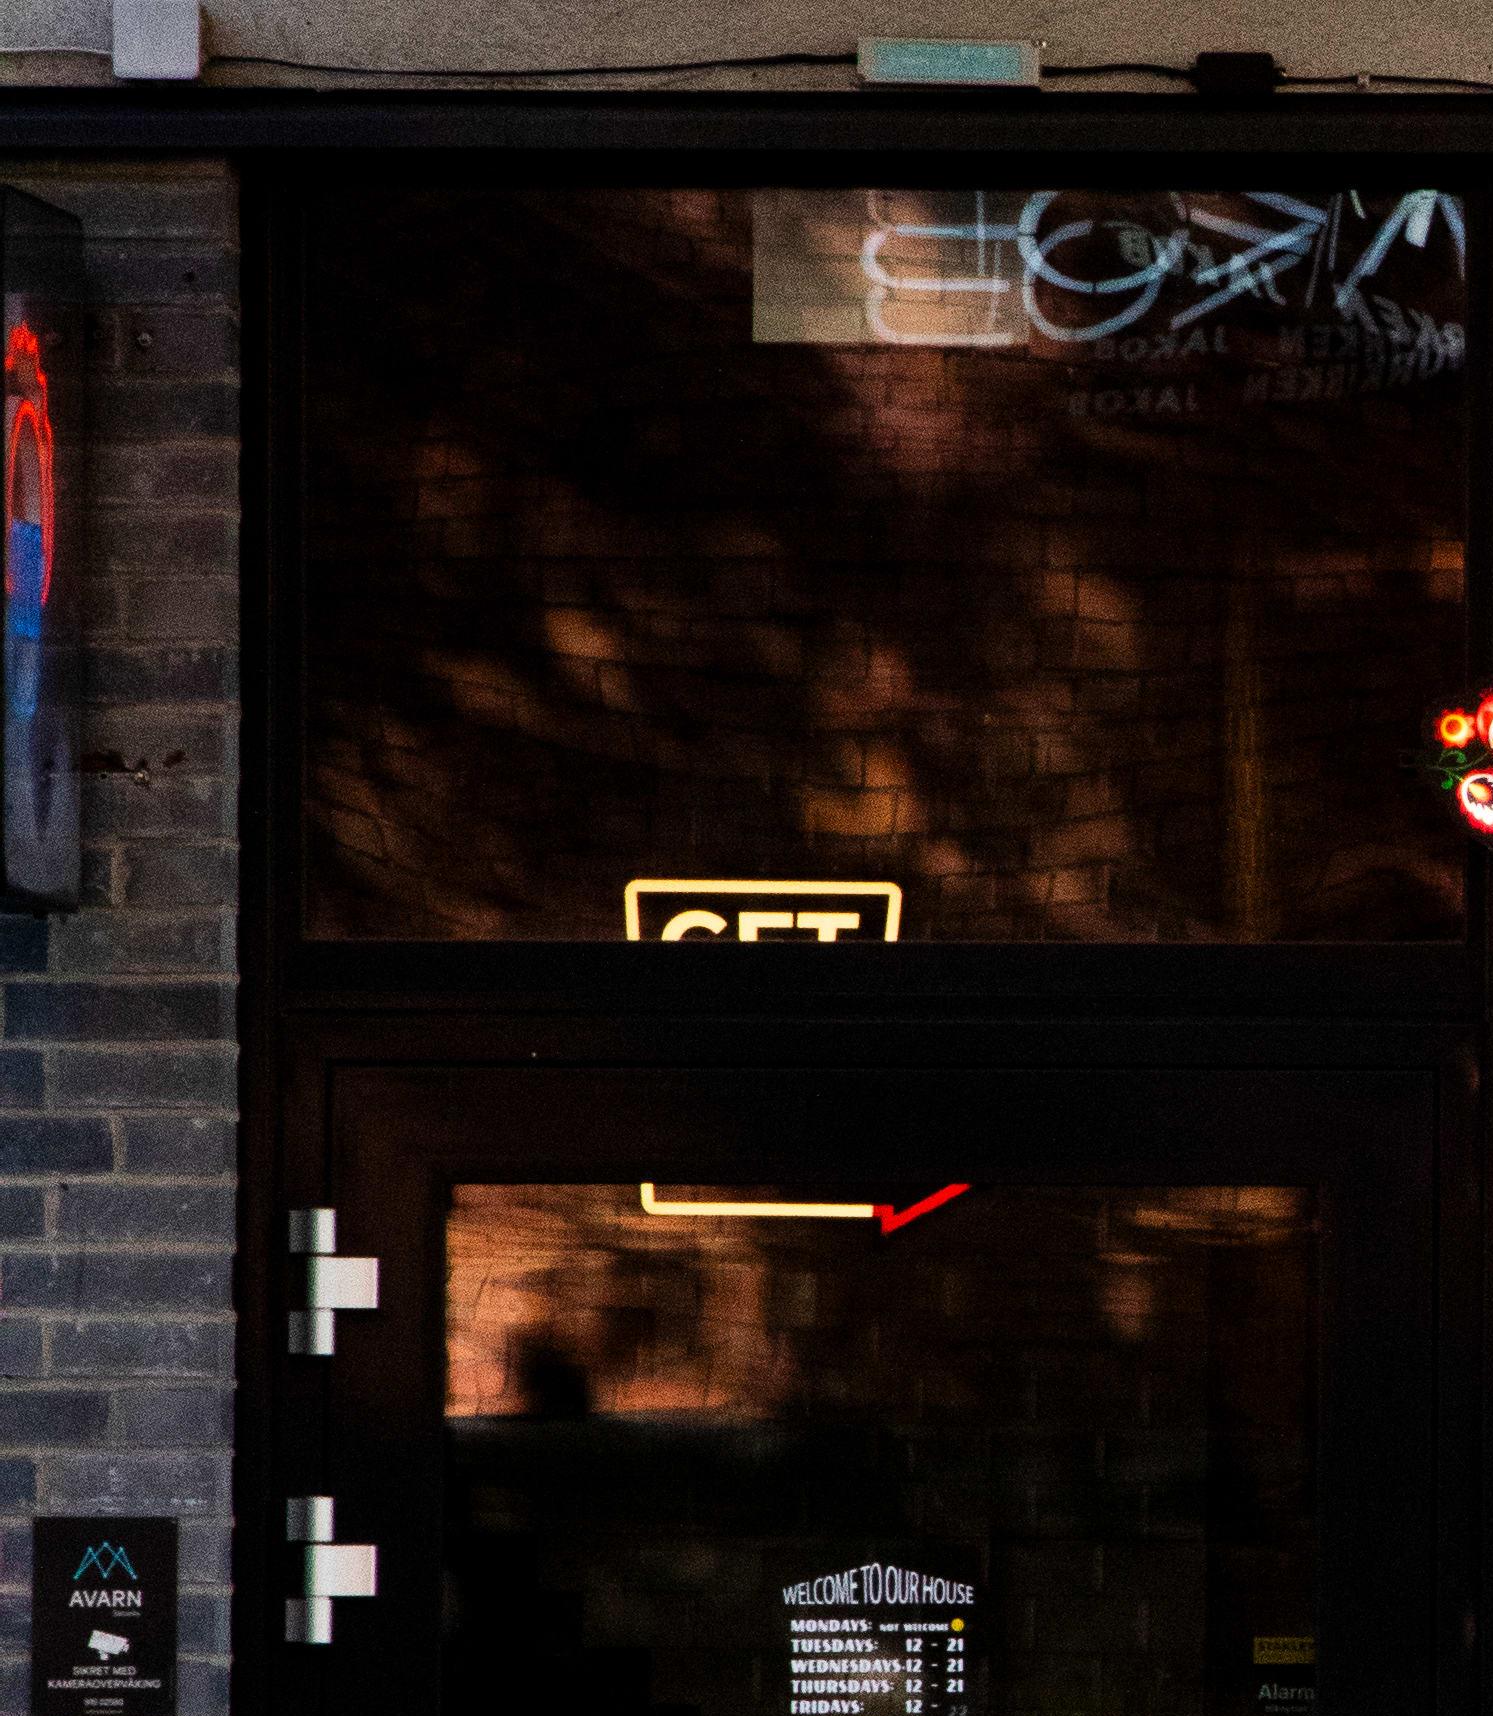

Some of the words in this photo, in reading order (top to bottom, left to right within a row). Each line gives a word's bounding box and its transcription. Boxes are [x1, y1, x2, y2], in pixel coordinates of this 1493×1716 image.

[782, 1569, 859, 1605] WELCOME
[860, 1562, 881, 1604] TO
[885, 1566, 920, 1604] OUR
[922, 1574, 974, 1604] HOUSE
[69, 1590, 143, 1608] AVARN
[790, 1619, 872, 1632] MONDAYS:
[879, 1624, 899, 1632] NOT
[904, 1623, 949, 1632] WELCOME
[790, 1639, 879, 1652] TUESDAYS:
[905, 1639, 922, 1652] 12
[946, 1639, 964, 1652] 21
[72, 1665, 109, 1676] SIKRET
[112, 1665, 137, 1676] MED
[905, 1659, 922, 1672] 12
[946, 1659, 964, 1672] 21
[790, 1680, 894, 1693] THURSDAYS:
[905, 1680, 922, 1693] 12
[946, 1680, 964, 1692] 21
[1257, 1682, 1316, 1701] Alarm
[790, 1700, 864, 1714] FRIDAYS:
[905, 1700, 922, 1713] 12
